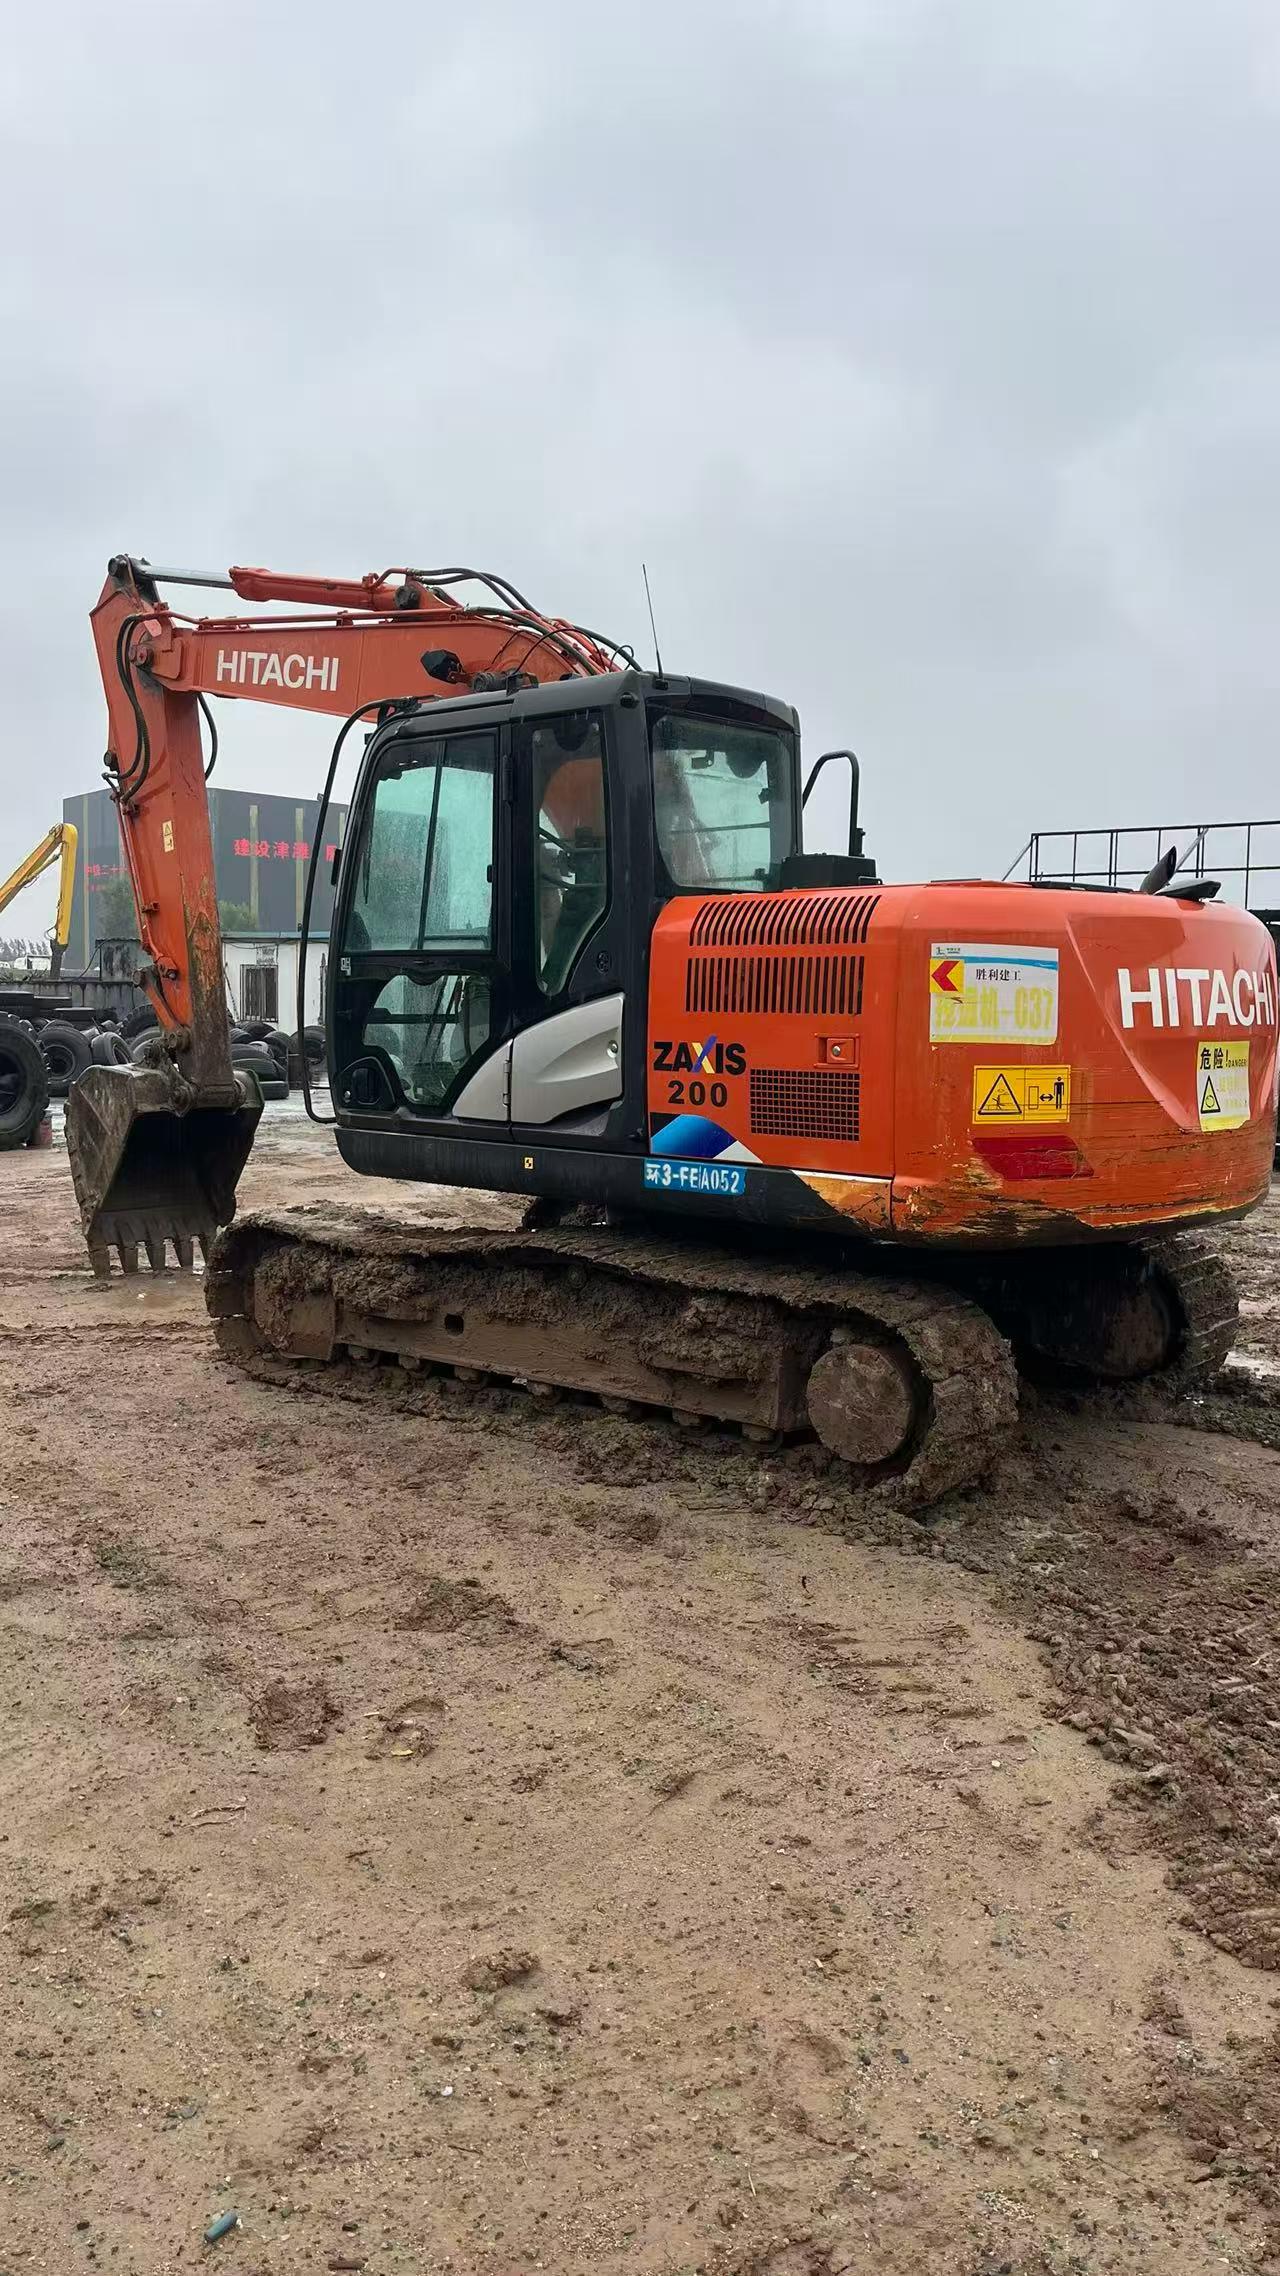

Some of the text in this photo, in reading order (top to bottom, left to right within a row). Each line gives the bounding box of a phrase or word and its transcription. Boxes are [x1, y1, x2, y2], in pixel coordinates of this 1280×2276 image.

[217, 650, 339, 691] HITACHI
[975, 968, 1022, 981] 胜利建工
[1117, 968, 1275, 1028] HITACHI
[653, 1035, 746, 1075] ZAXIS
[668, 1080, 728, 1108] 200
